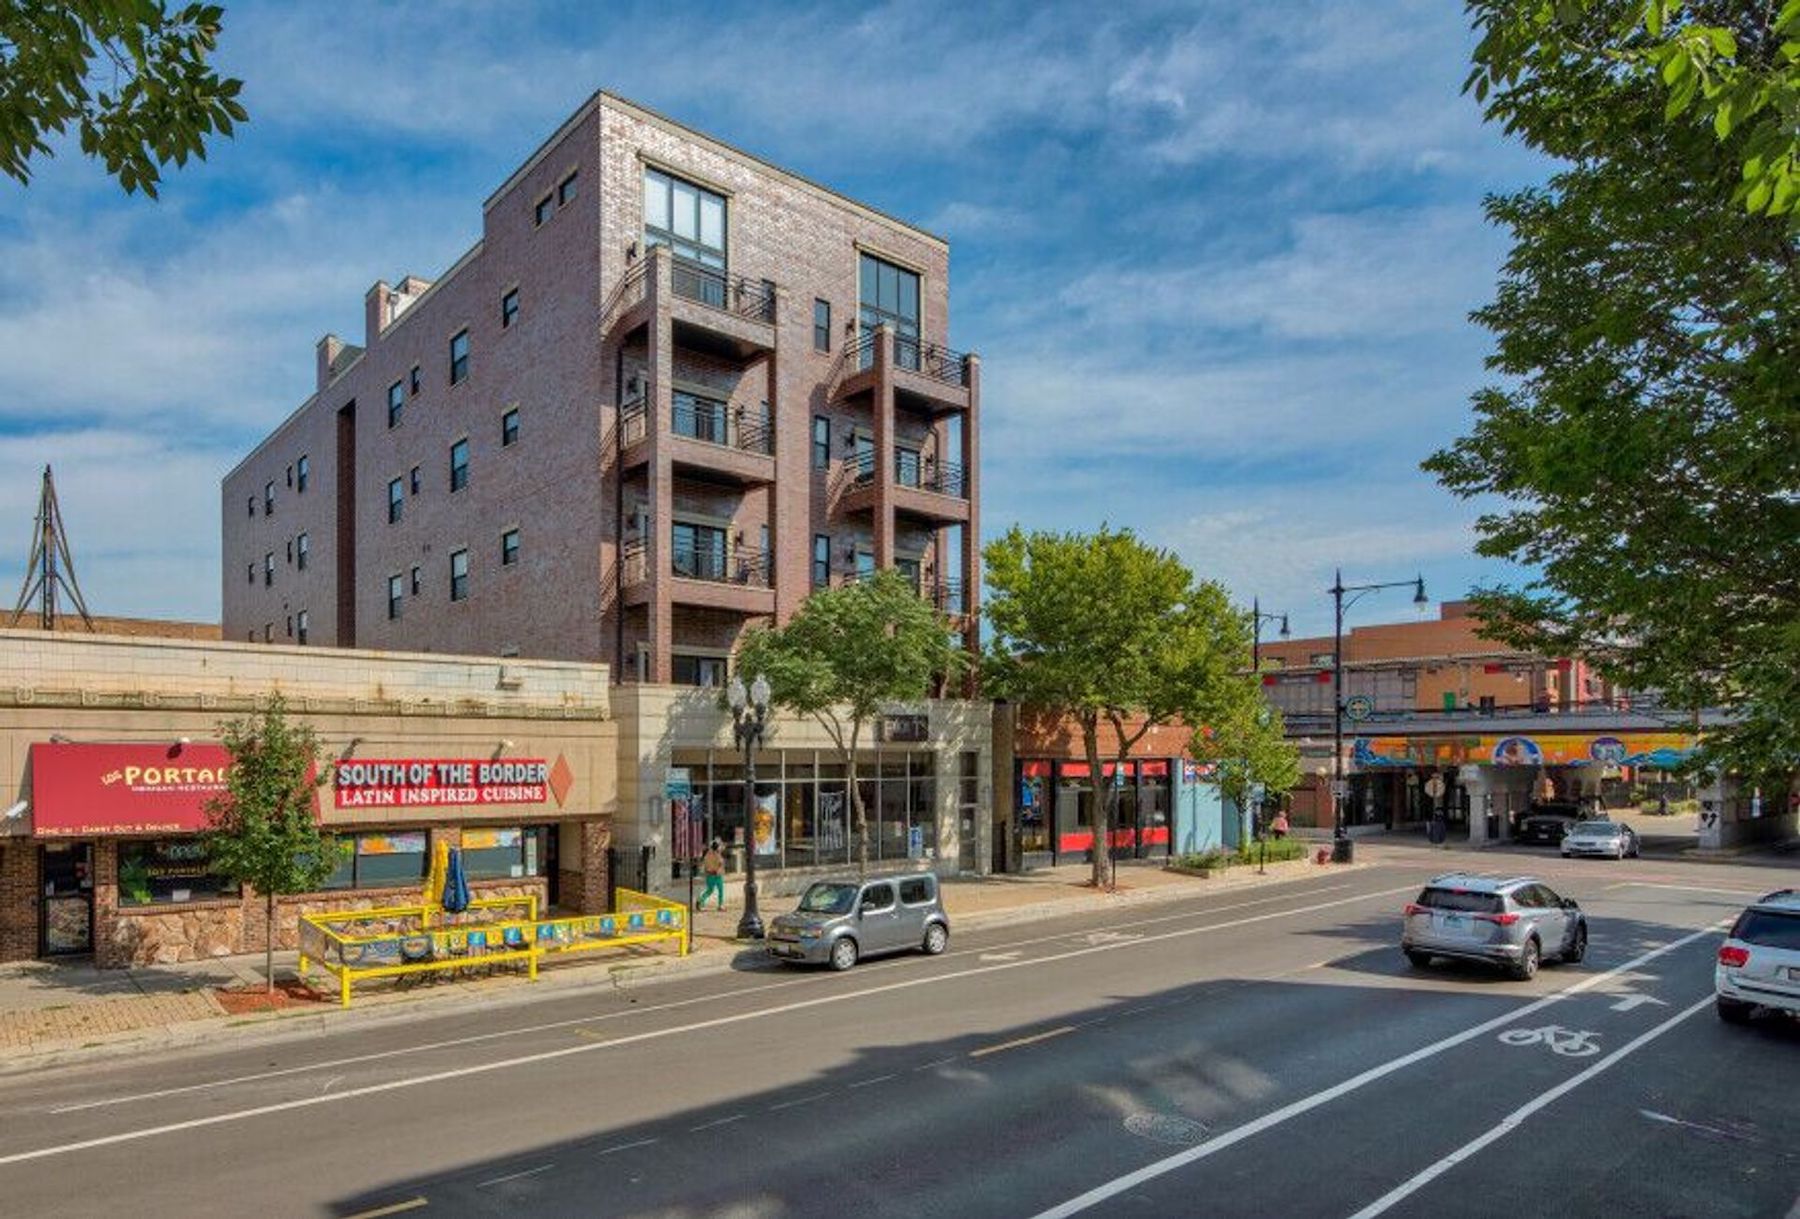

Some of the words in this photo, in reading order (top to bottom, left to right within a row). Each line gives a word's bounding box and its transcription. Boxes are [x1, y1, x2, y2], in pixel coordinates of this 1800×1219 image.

[340, 763, 405, 785] SOUTH
[410, 763, 434, 784] OF
[438, 763, 472, 784] THE
[480, 763, 547, 784] BORDER
[341, 787, 395, 805] LATIN
[400, 786, 478, 804] INSPIRED
[482, 784, 543, 802] CUISINE
